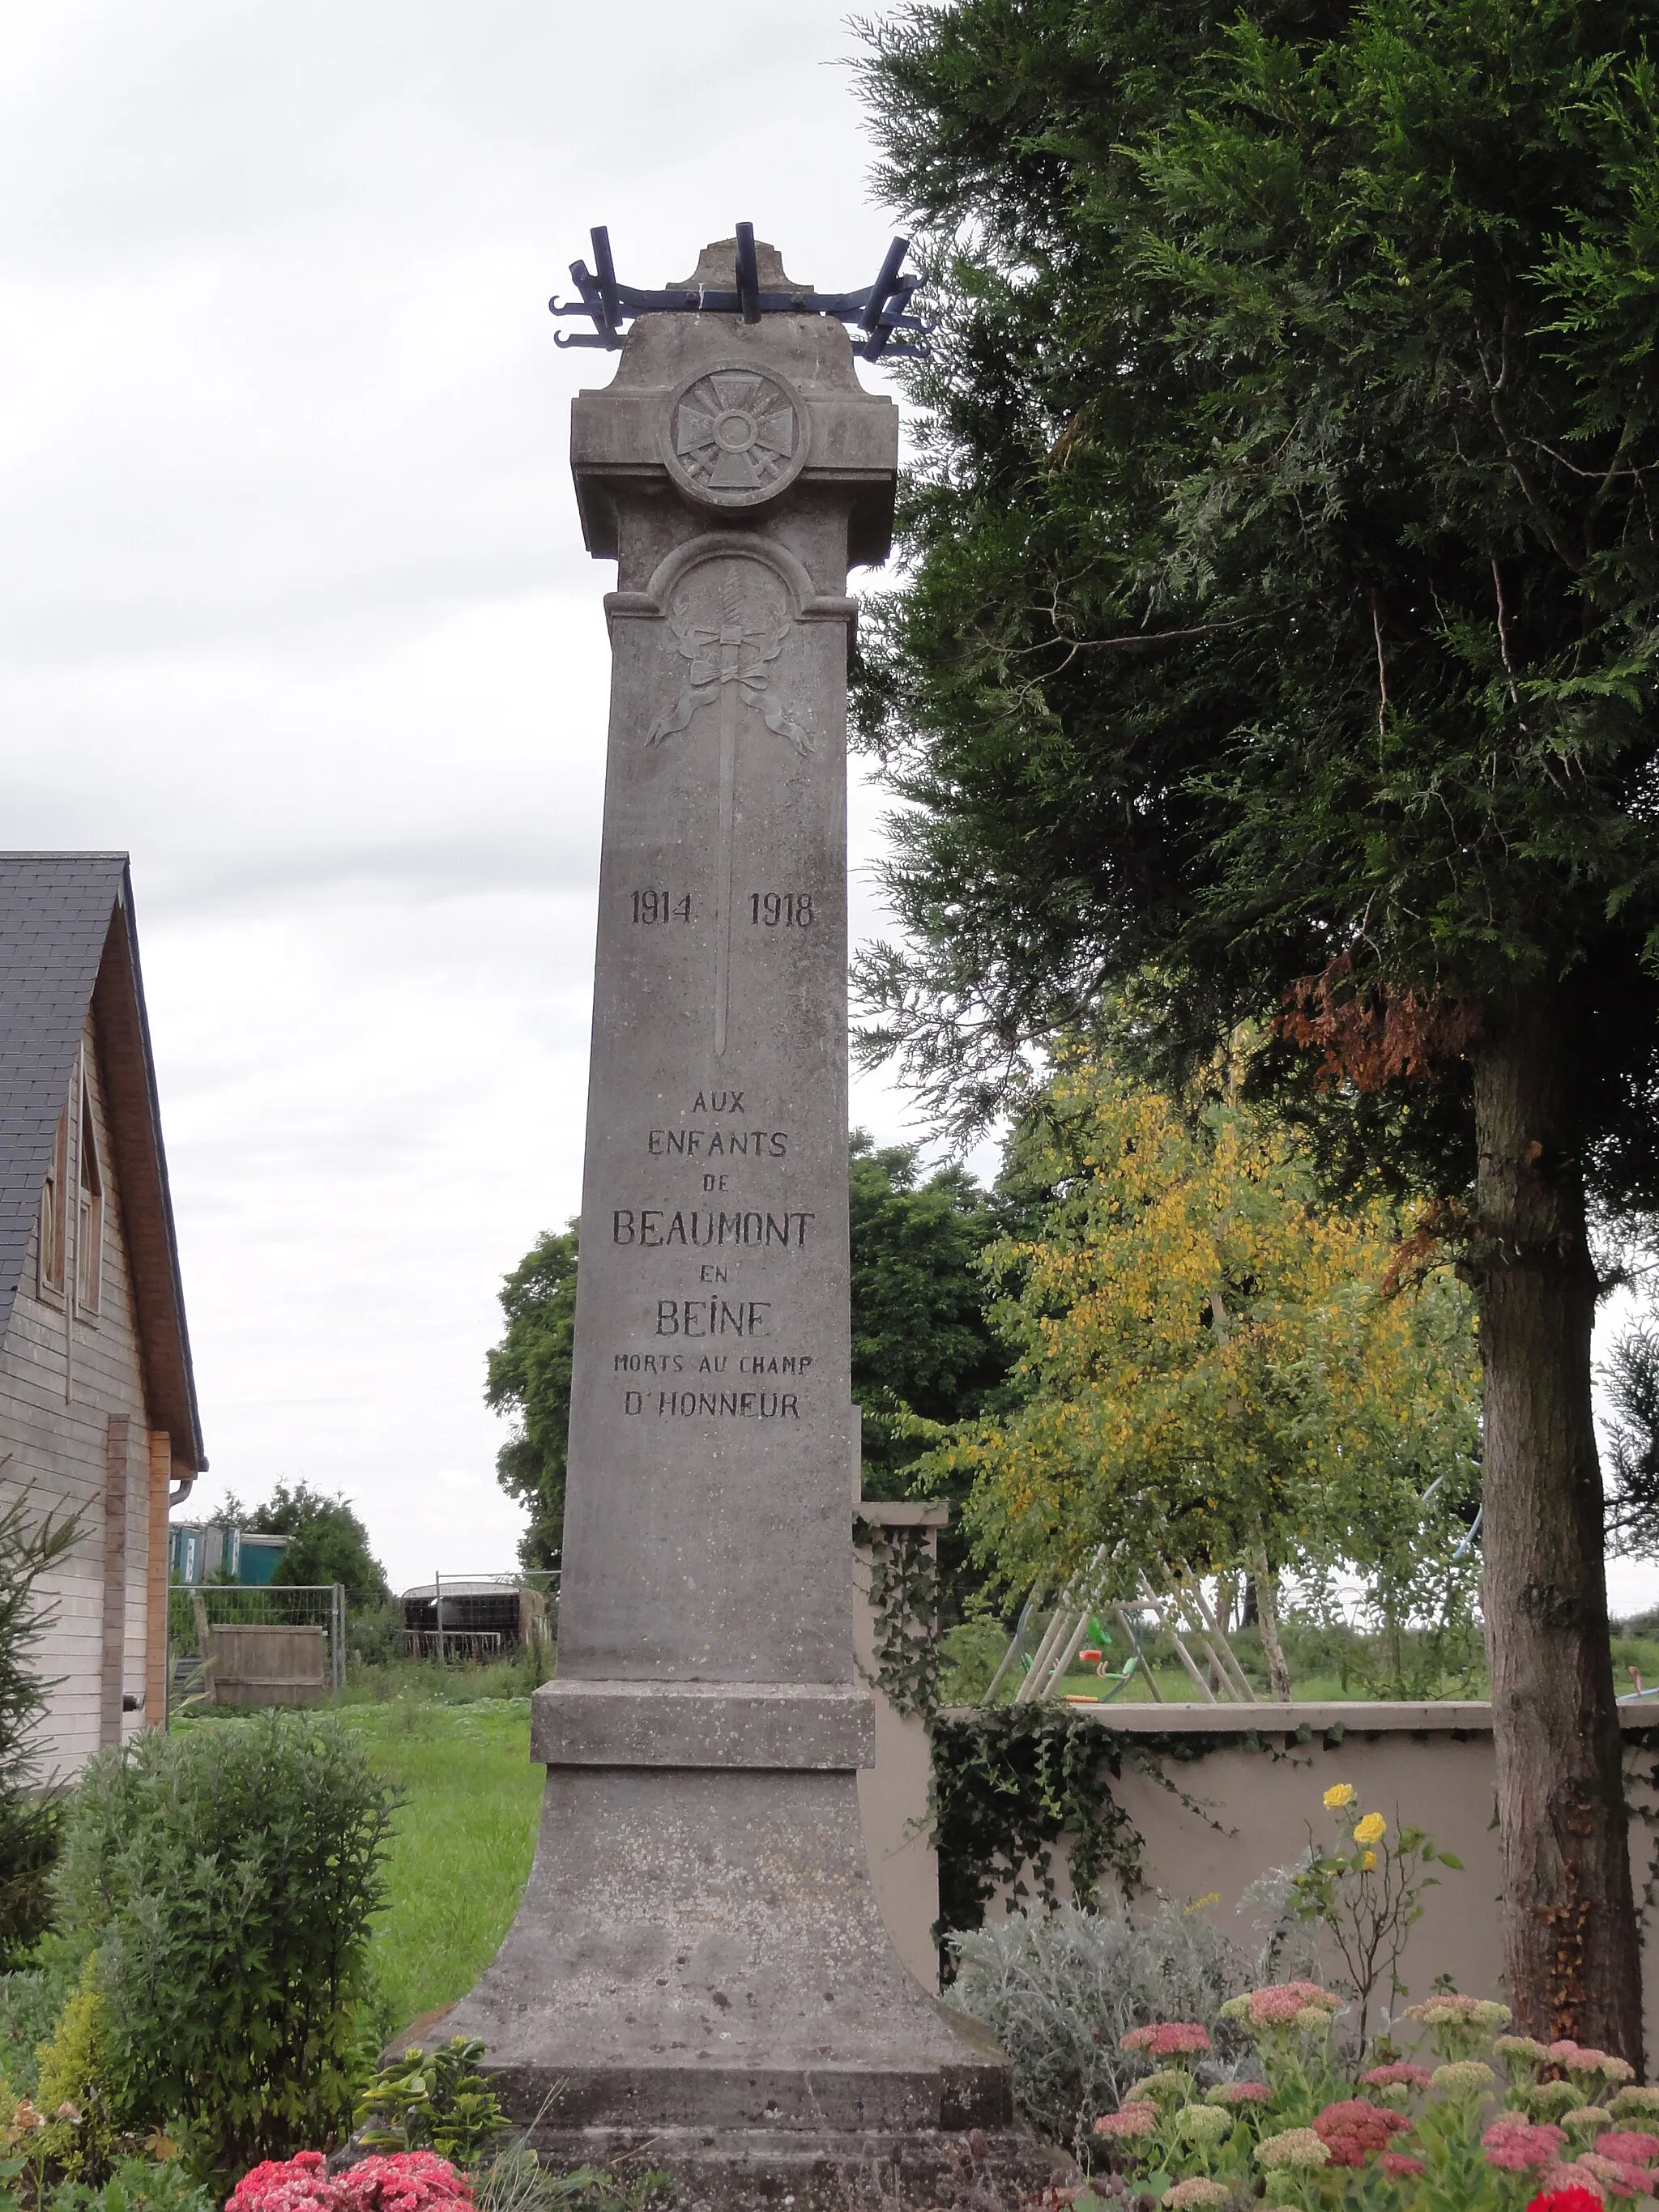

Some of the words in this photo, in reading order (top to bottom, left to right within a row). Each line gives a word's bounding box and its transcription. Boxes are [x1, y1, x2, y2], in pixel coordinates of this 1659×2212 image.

[630, 890, 693, 924] 1914
[748, 892, 813, 927] 1918
[692, 1091, 744, 1114] AUX
[648, 1130, 787, 1157] ENFANTS
[703, 1174, 729, 1192] DE
[613, 1210, 815, 1248] BEAUMONT
[700, 1264, 727, 1283] EN
[614, 1354, 684, 1374] MORTS
[699, 1356, 727, 1373] AU
[740, 1356, 811, 1375] CHAMP
[625, 1391, 800, 1418] D'HONNEUR
